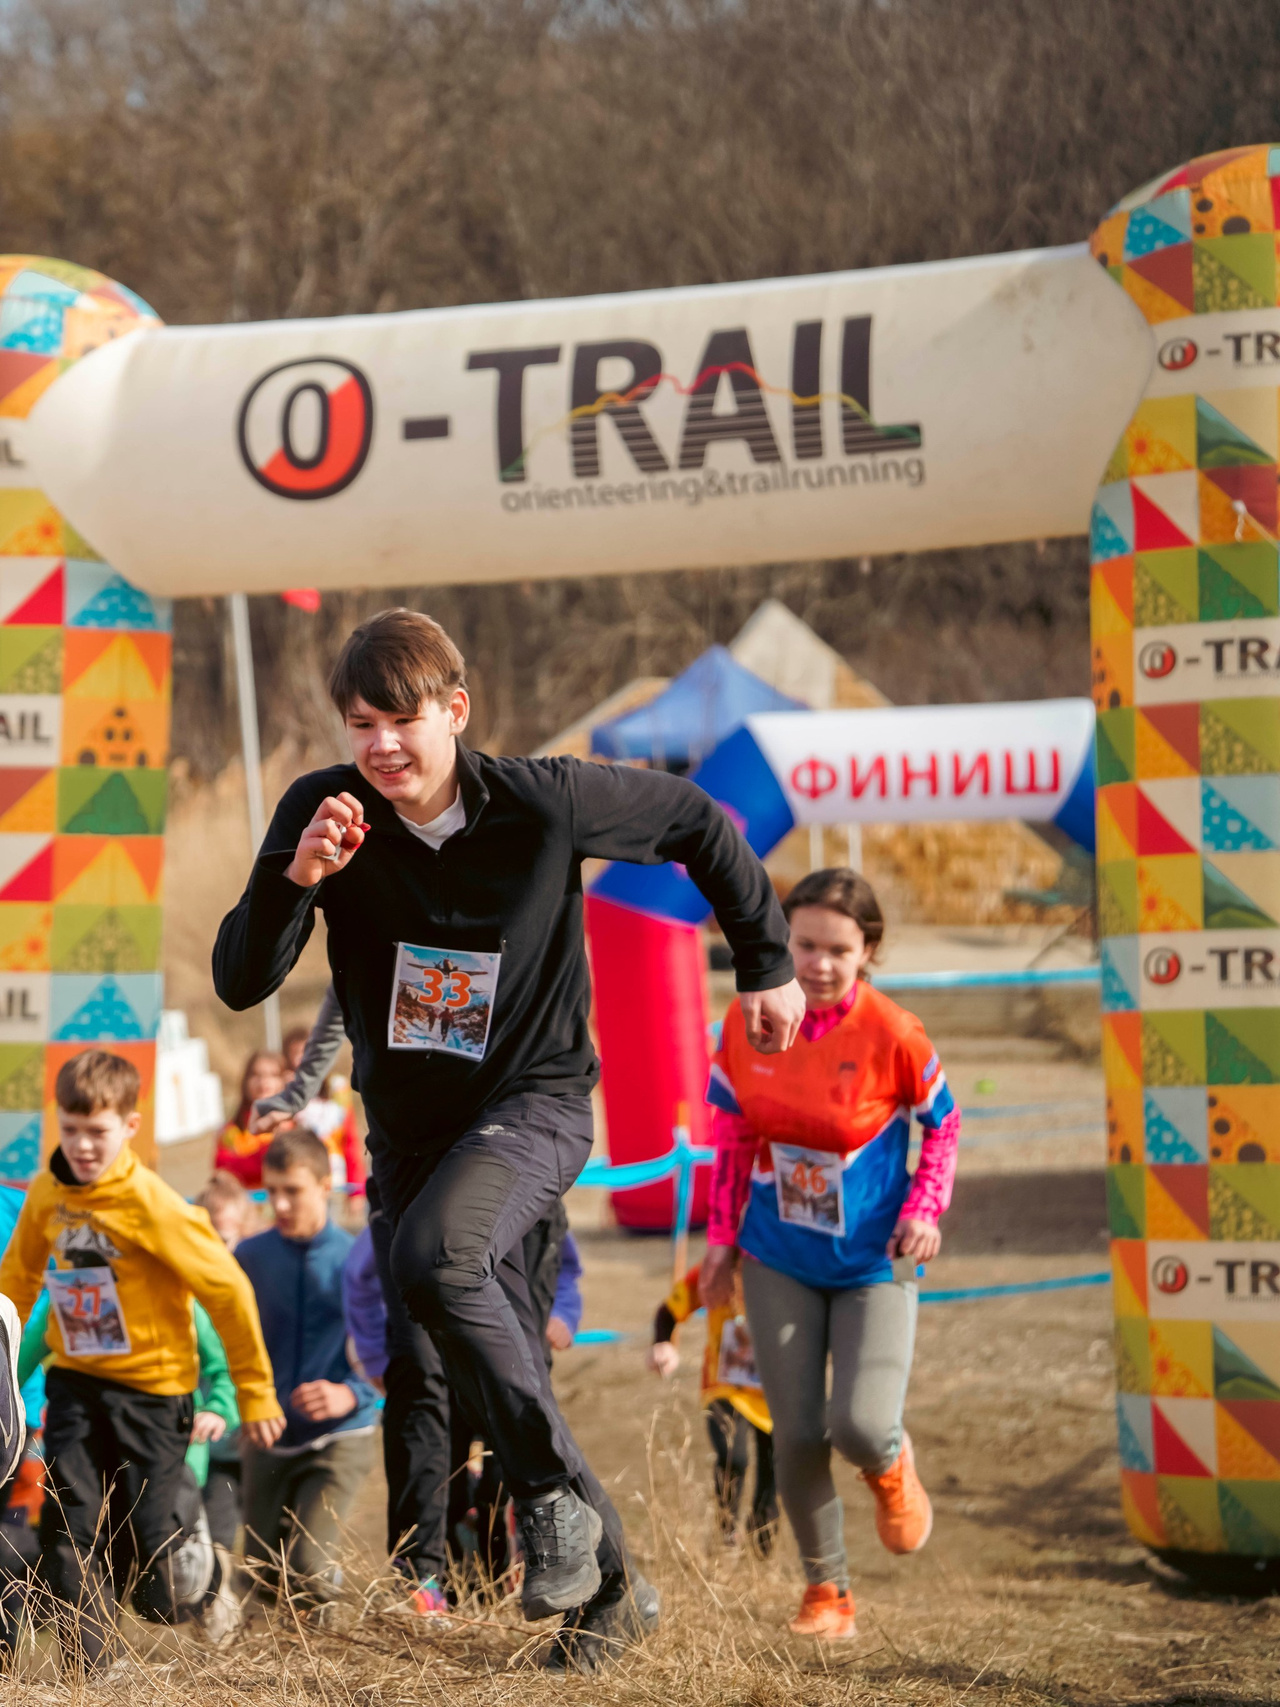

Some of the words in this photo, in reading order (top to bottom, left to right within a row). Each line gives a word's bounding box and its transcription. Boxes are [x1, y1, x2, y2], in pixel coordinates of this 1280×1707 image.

[500, 453, 925, 515] orienteering&trailrunning
[1139, 636, 1280, 679] O-TR
[789, 749, 1060, 799] ФИНИШ
[418, 967, 472, 1008] 33
[791, 1162, 828, 1194] 46
[66, 1286, 101, 1319] 27
